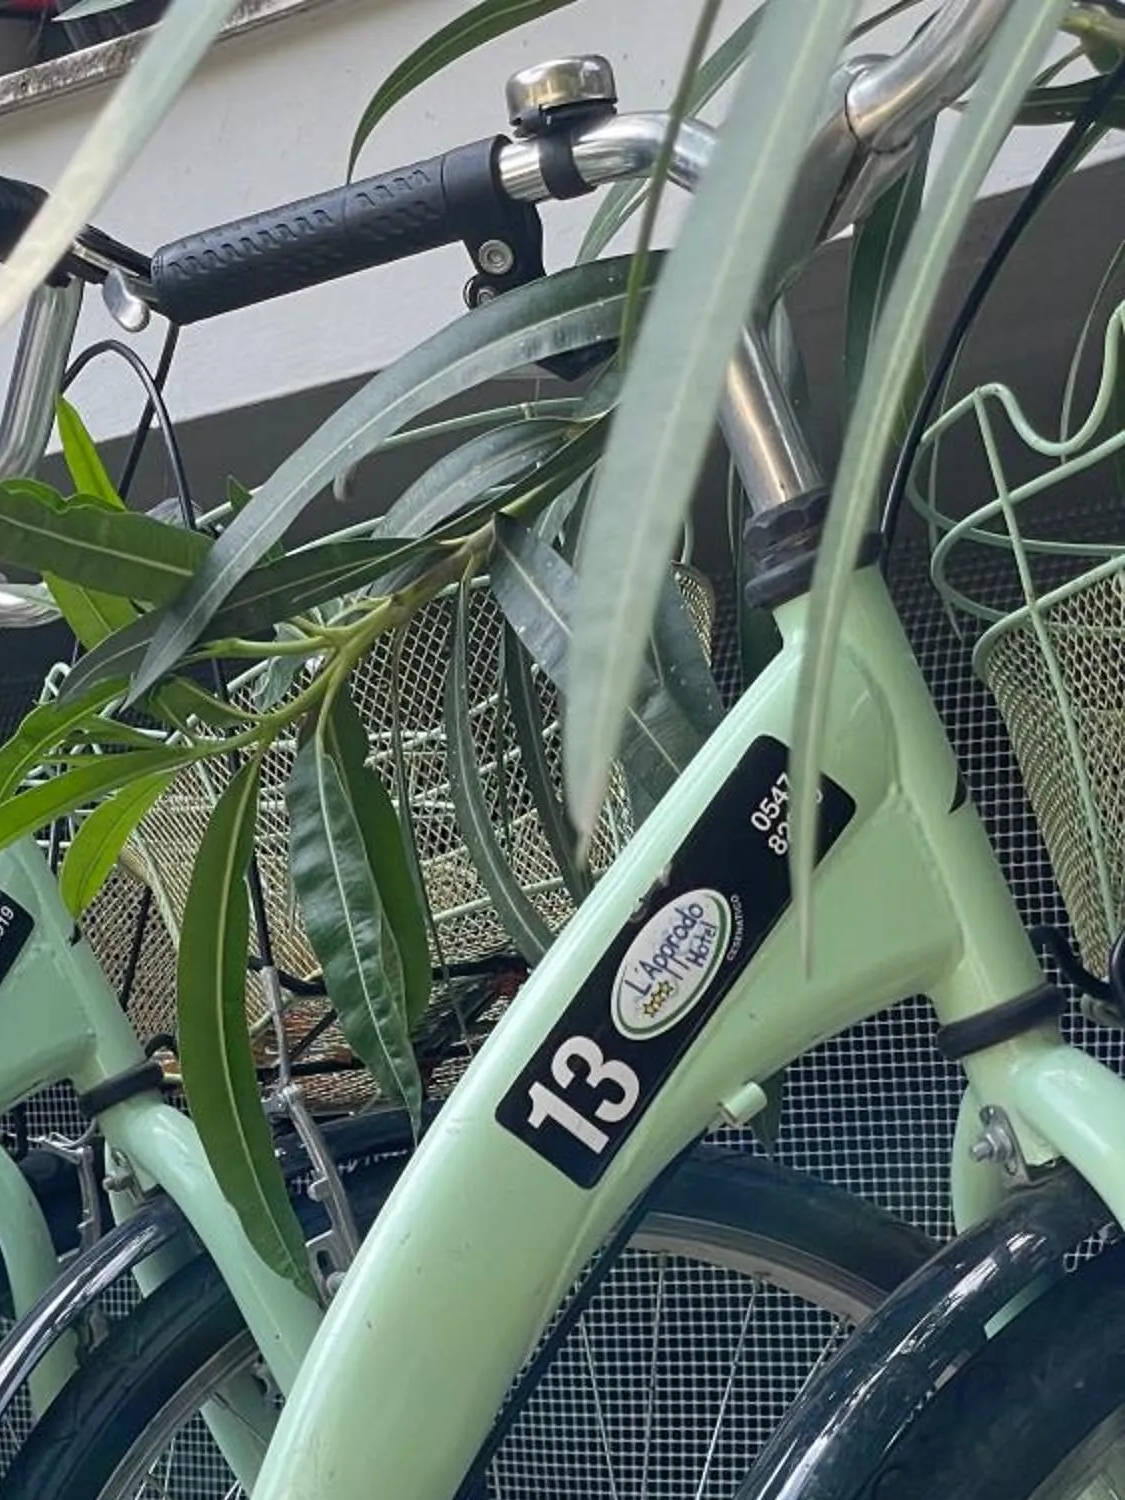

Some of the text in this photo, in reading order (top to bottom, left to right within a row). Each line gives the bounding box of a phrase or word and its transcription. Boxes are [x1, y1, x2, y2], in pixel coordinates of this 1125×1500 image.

[751, 772, 792, 831] 0547
[625, 903, 704, 996] L'Approdo
[684, 920, 718, 968] Hotel
[527, 1035, 640, 1154] 13
